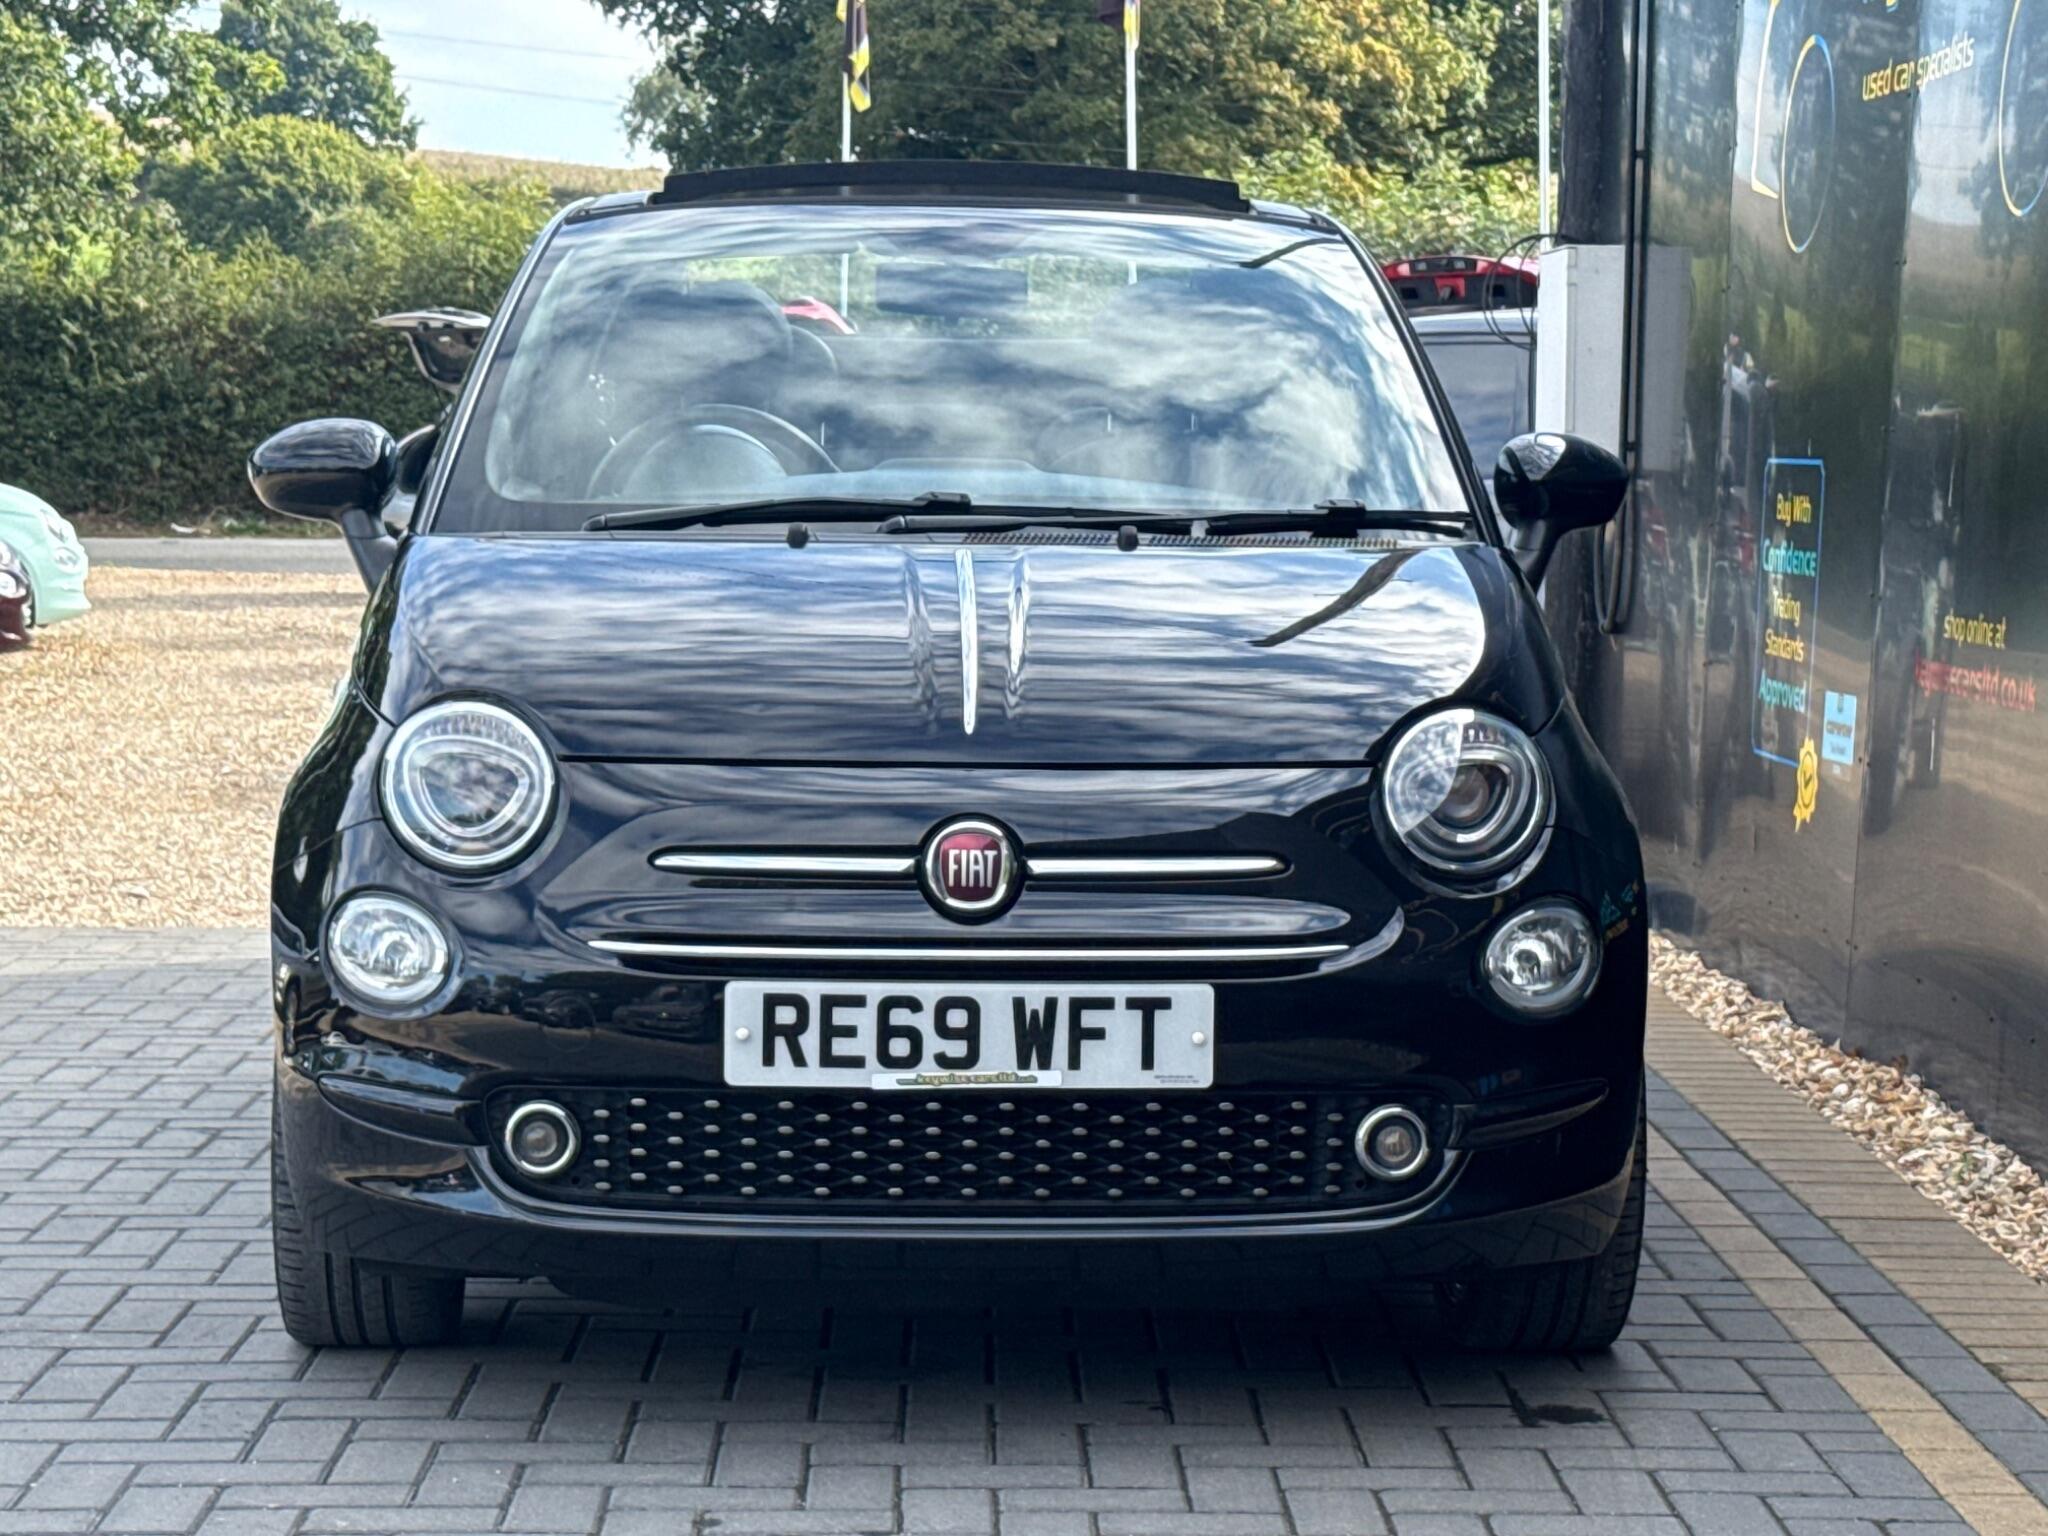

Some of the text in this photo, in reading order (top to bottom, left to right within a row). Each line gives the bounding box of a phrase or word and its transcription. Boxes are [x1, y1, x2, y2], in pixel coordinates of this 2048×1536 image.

[1862, 30, 1975, 101] used car specialists
[1763, 537, 1816, 577] Confidence
[1759, 667, 1806, 713] Approved
[948, 848, 998, 889] FIAT
[762, 992, 1172, 1072] RE69 WFT
